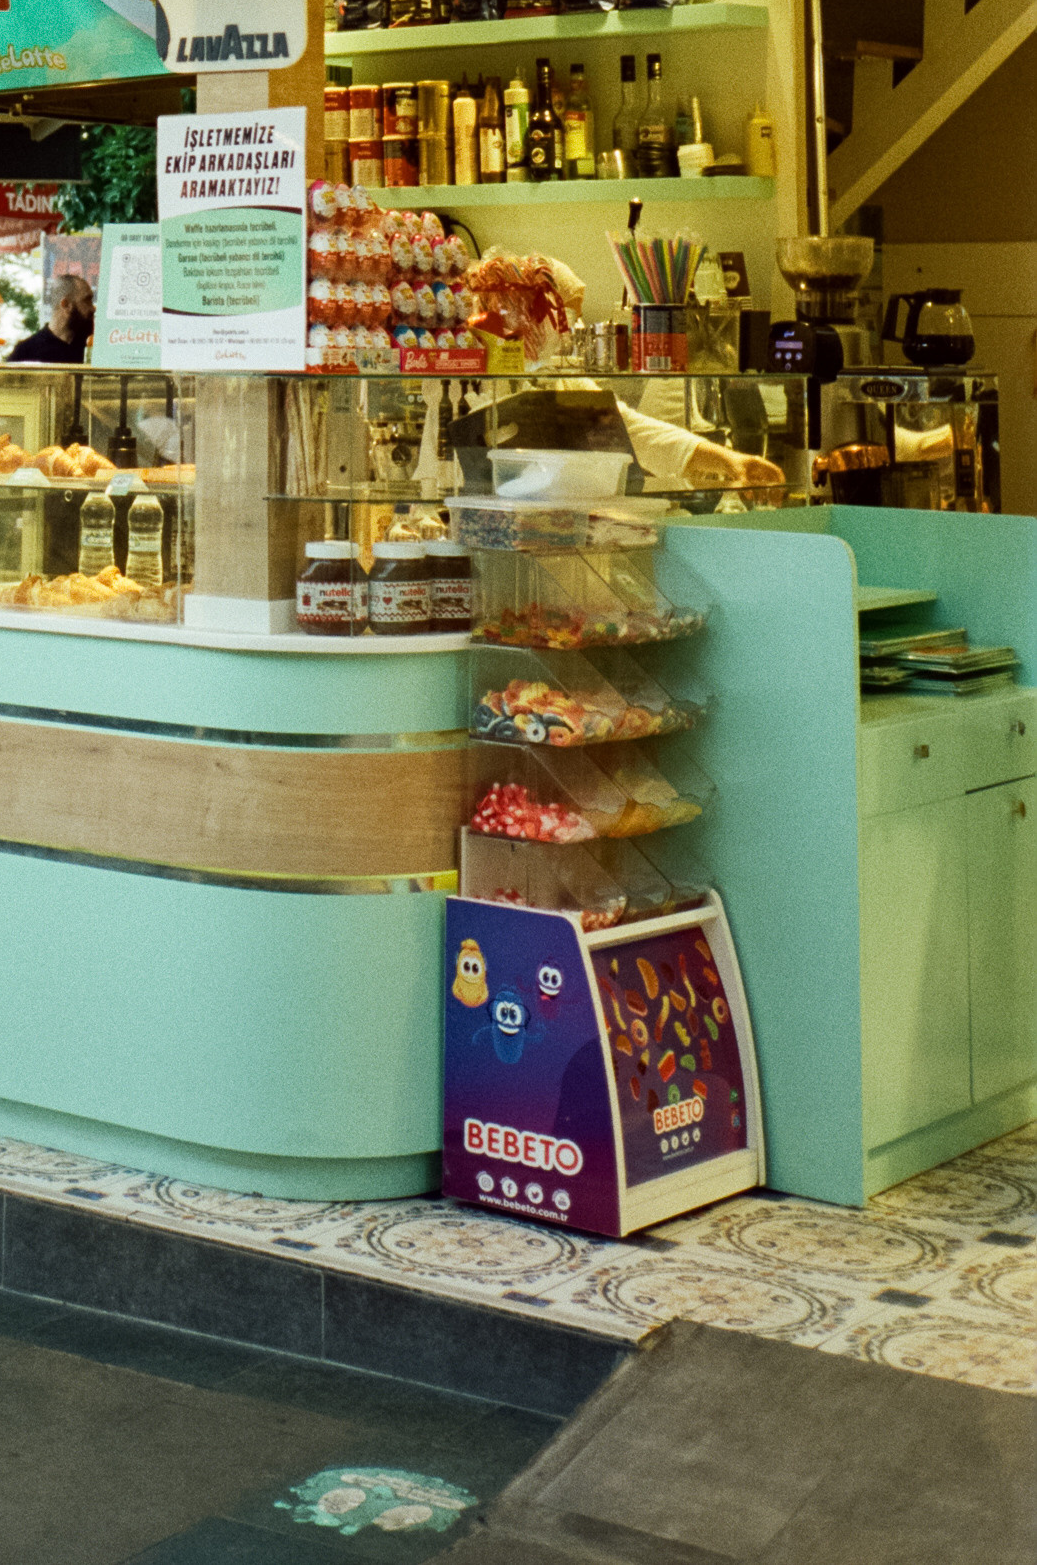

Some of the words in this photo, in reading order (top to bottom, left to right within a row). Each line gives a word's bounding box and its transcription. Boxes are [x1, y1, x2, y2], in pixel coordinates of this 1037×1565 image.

[176, 24, 290, 63] LAVAZZA
[184, 122, 275, 152] İŞLETMEMİZE
[165, 152, 196, 174] EKİP
[198, 149, 295, 174] ARKADAŞLARI
[180, 176, 280, 199] ARAMAKTAYIZ!
[5, 192, 55, 214] TADIN
[109, 326, 161, 345] GeLatt
[654, 1097, 703, 1133] BEBETO
[465, 1120, 582, 1174] BEBETO
[478, 1192, 570, 1222] www.bebeto.com.tr
